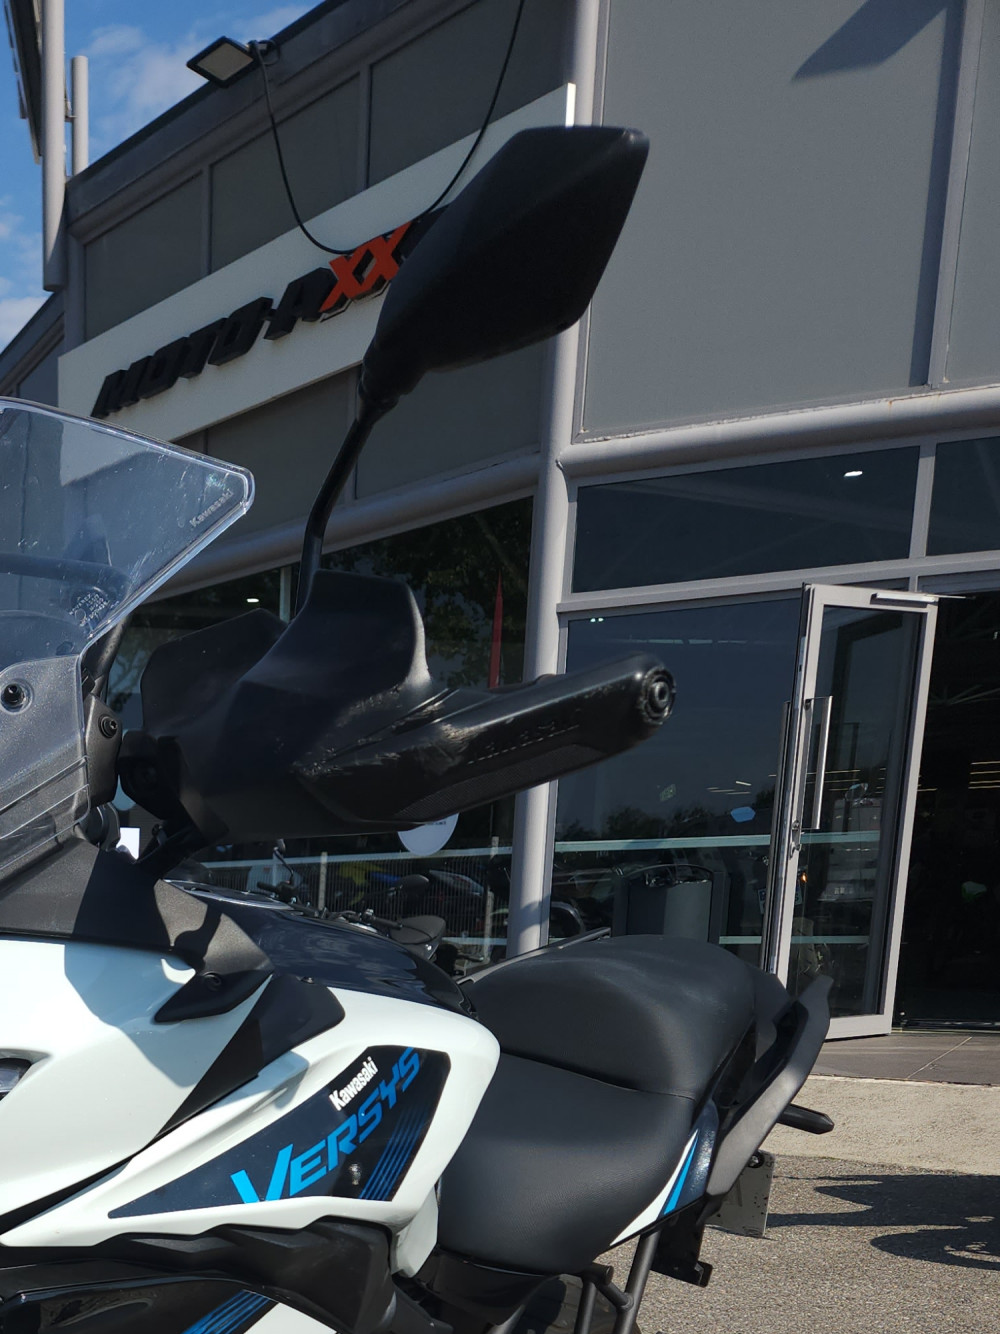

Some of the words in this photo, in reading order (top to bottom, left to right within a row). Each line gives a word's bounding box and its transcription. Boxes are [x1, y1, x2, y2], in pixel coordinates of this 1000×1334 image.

[189, 488, 234, 527] Kawasaki
[329, 1056, 379, 1111] Kawasaki
[230, 1047, 420, 1204] VERSYS
